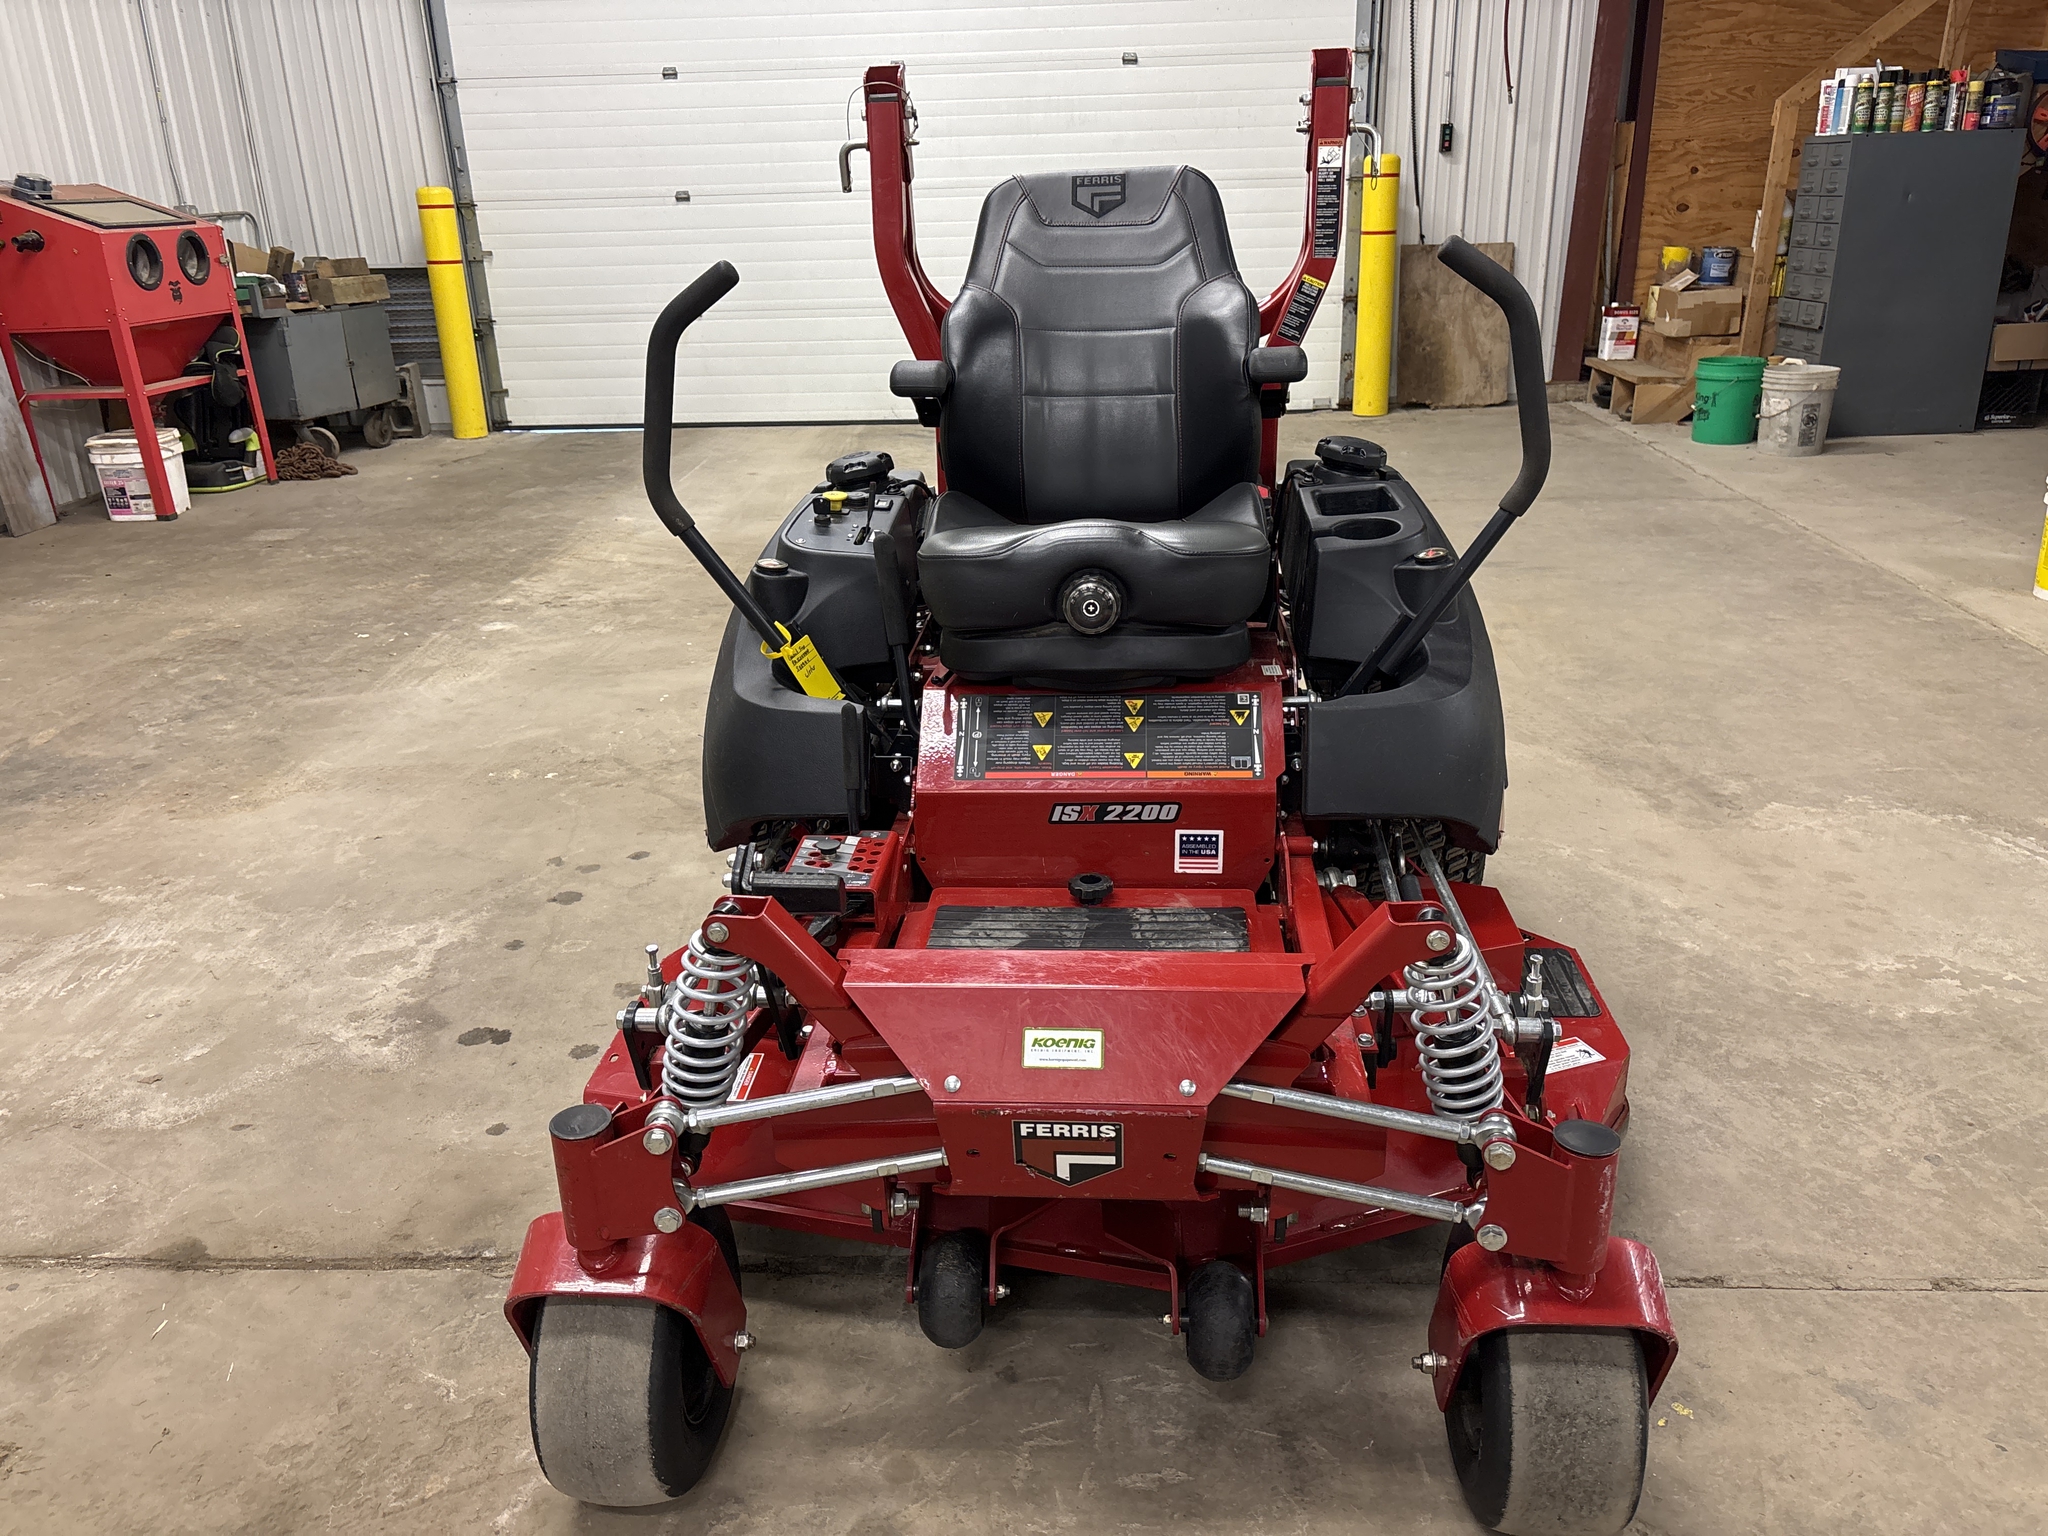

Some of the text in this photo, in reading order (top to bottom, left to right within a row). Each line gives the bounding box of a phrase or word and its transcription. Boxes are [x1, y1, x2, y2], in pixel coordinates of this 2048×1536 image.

[1076, 175, 1122, 185] FERRIS
[1306, 278, 1324, 288] CAUTION
[1052, 804, 1180, 822] ISX 2200
[1020, 1123, 1117, 1138] FERRIS
